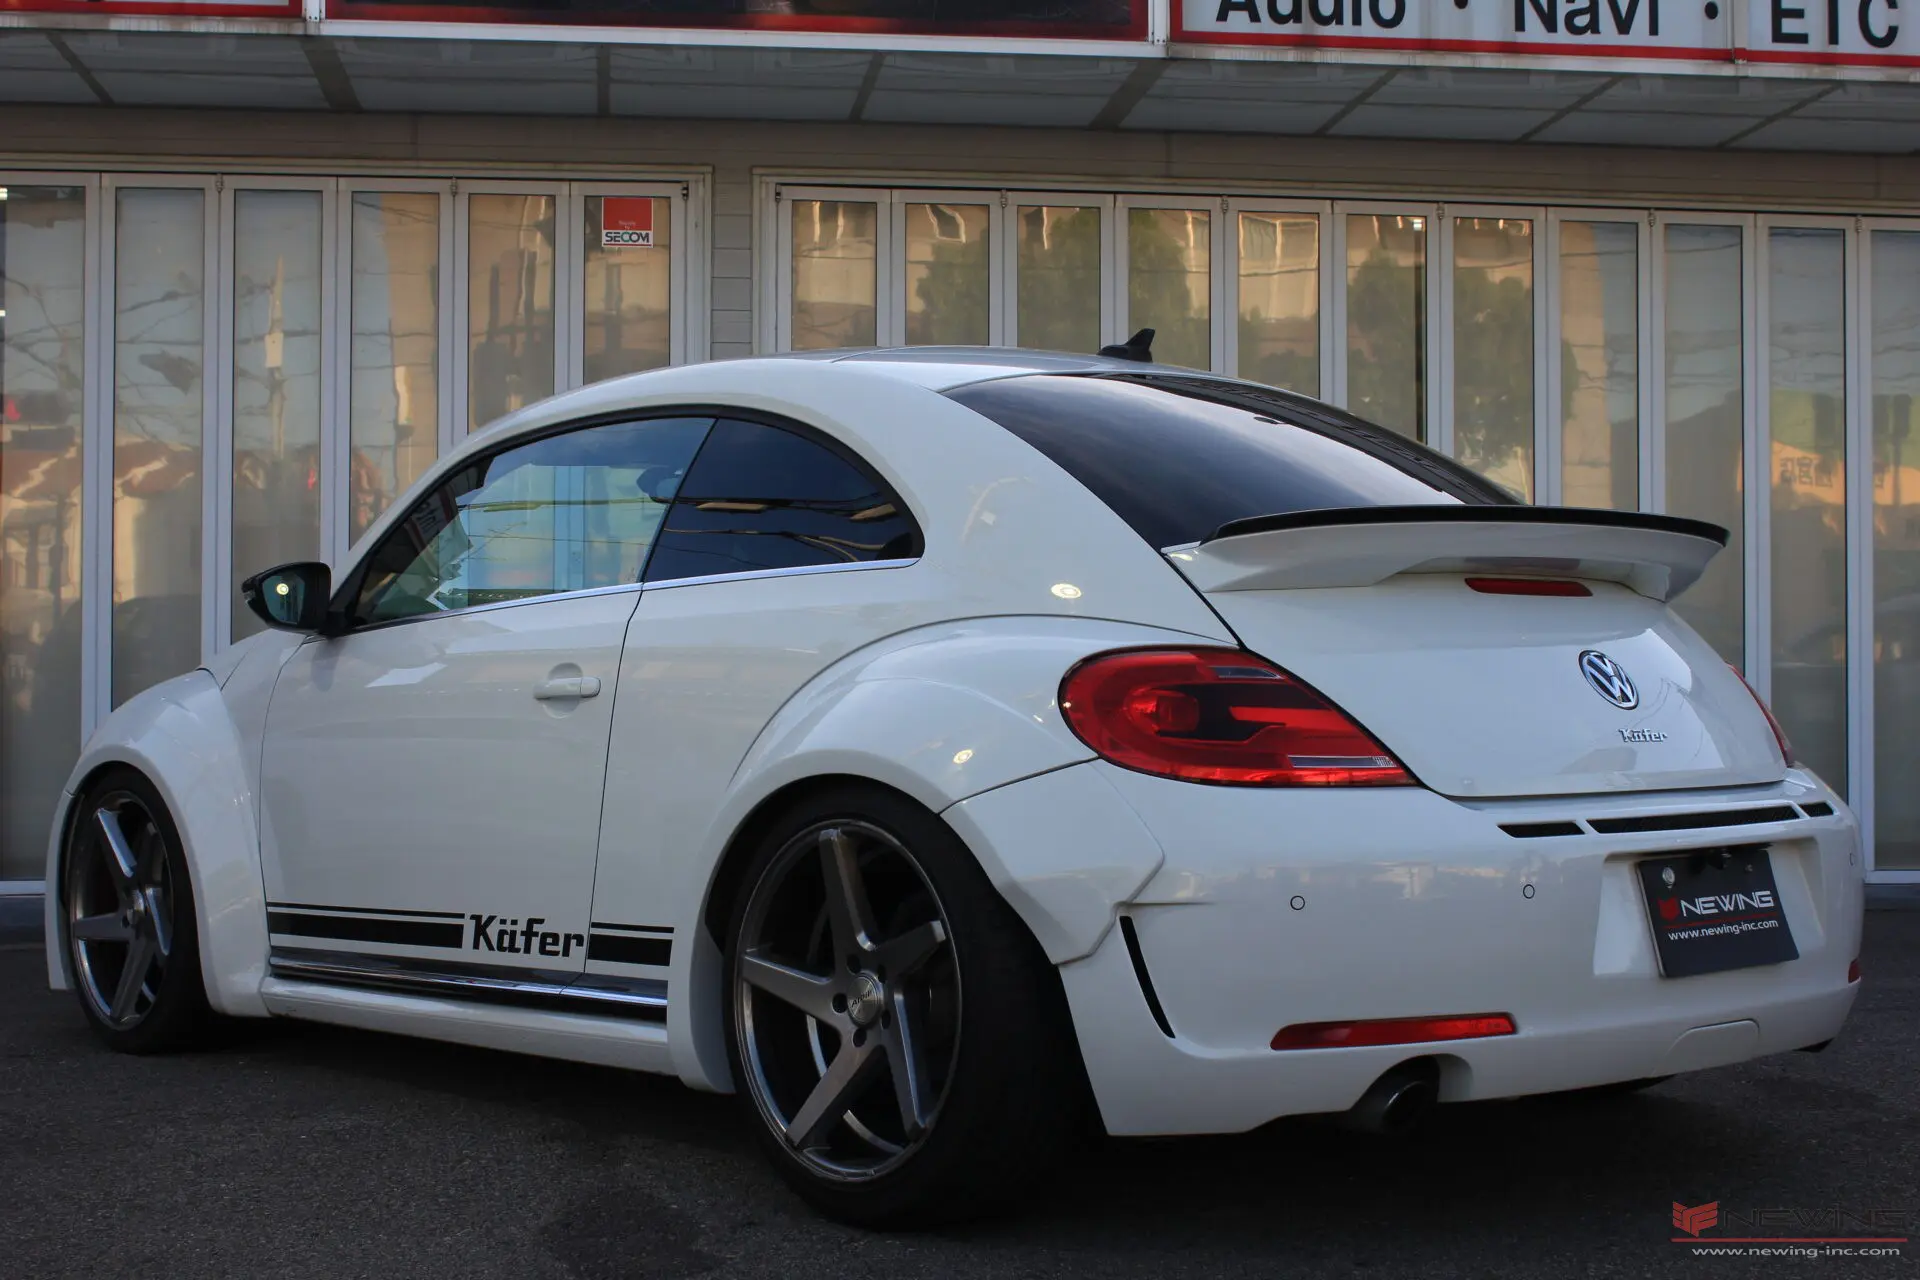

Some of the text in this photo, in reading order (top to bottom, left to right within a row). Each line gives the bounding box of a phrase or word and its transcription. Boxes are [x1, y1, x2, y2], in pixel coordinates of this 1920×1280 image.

[605, 231, 650, 243] SECOM
[1680, 890, 1775, 917] NEWING
[469, 914, 585, 958] Käfer
[1668, 918, 1779, 941] www.newing-inc.com
